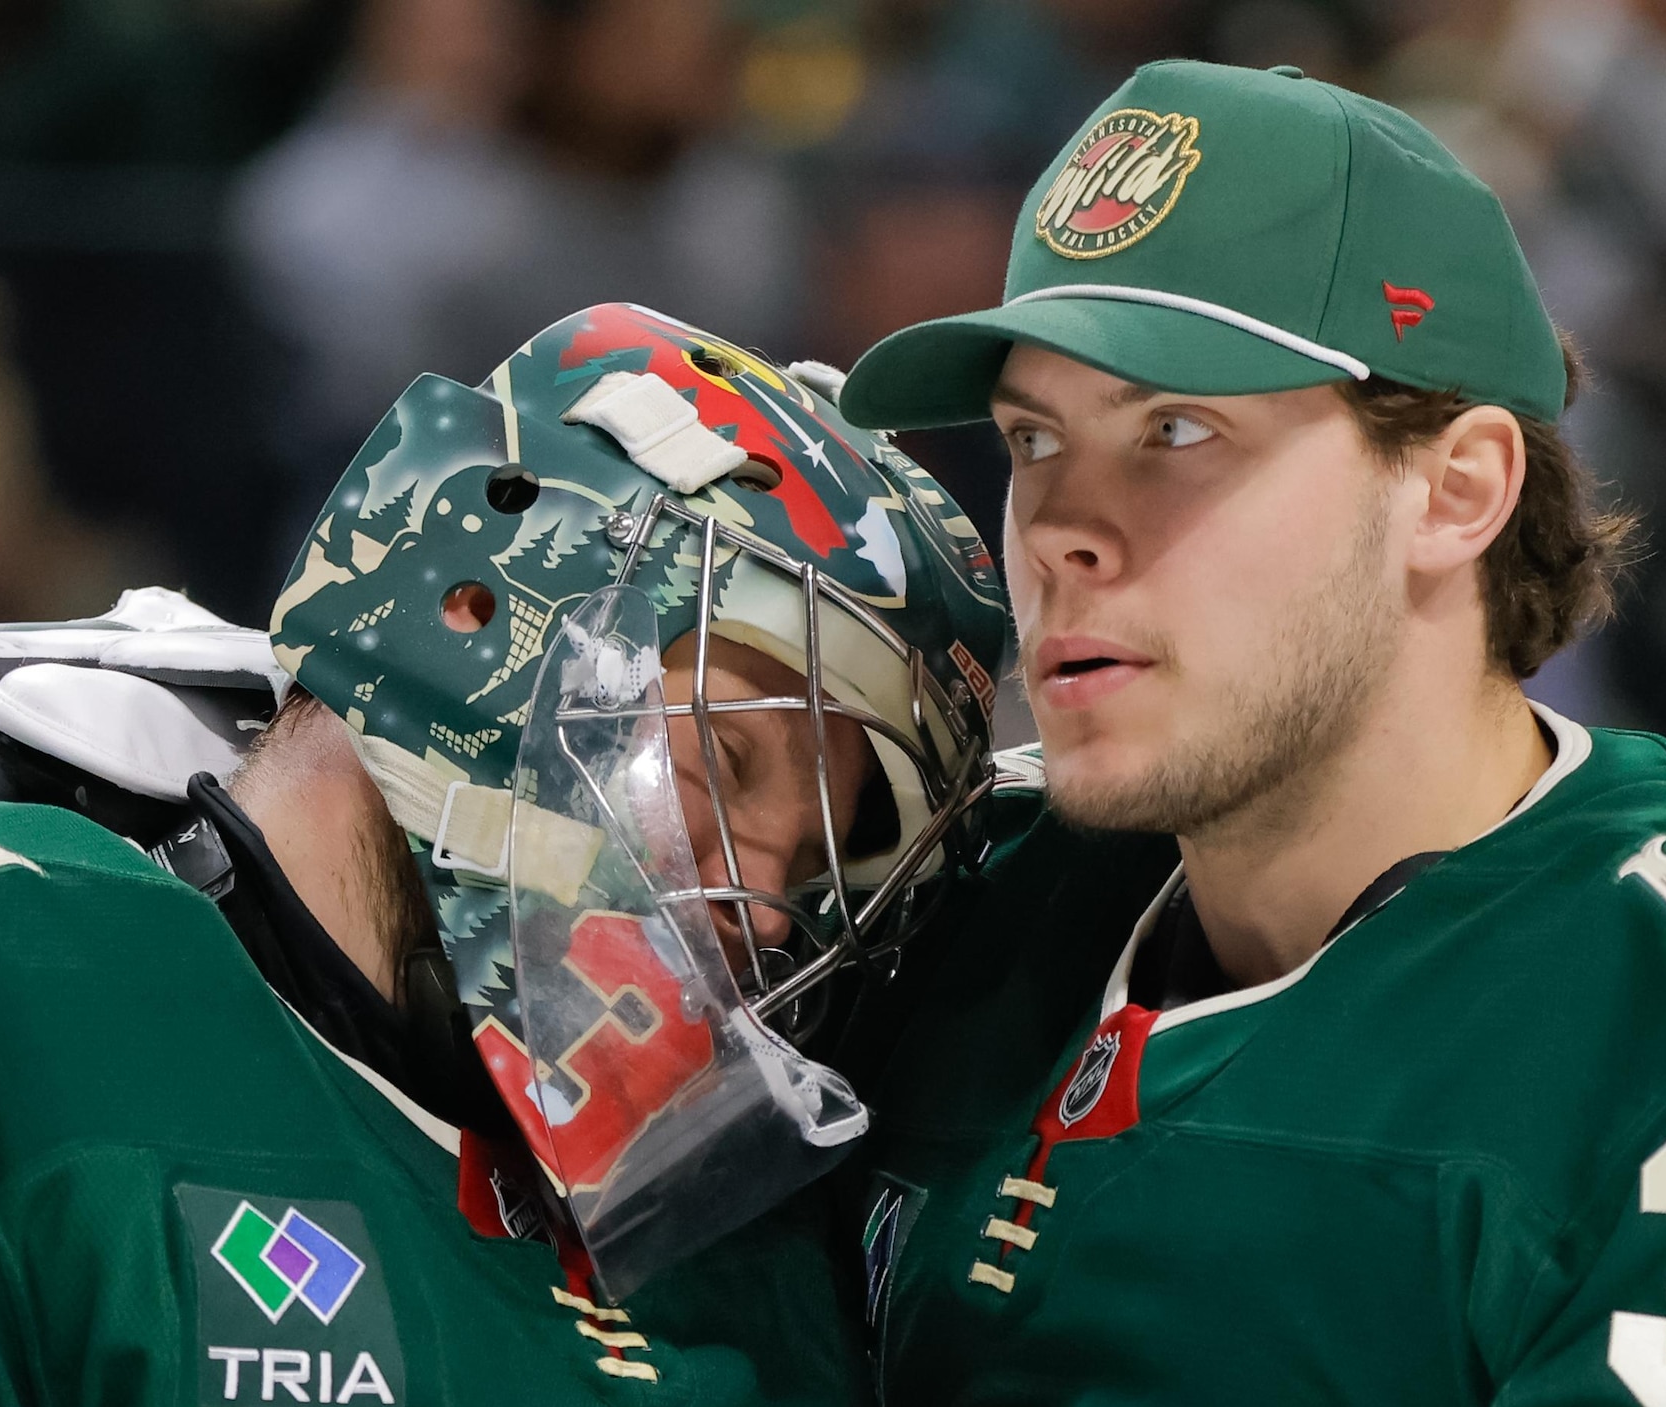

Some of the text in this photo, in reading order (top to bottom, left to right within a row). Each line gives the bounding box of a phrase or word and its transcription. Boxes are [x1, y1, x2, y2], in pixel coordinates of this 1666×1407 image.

[1071, 118, 1157, 164] MINNESOTA
[1059, 203, 1159, 249] NHL HOCKEY
[207, 1345, 396, 1405] TRIA
